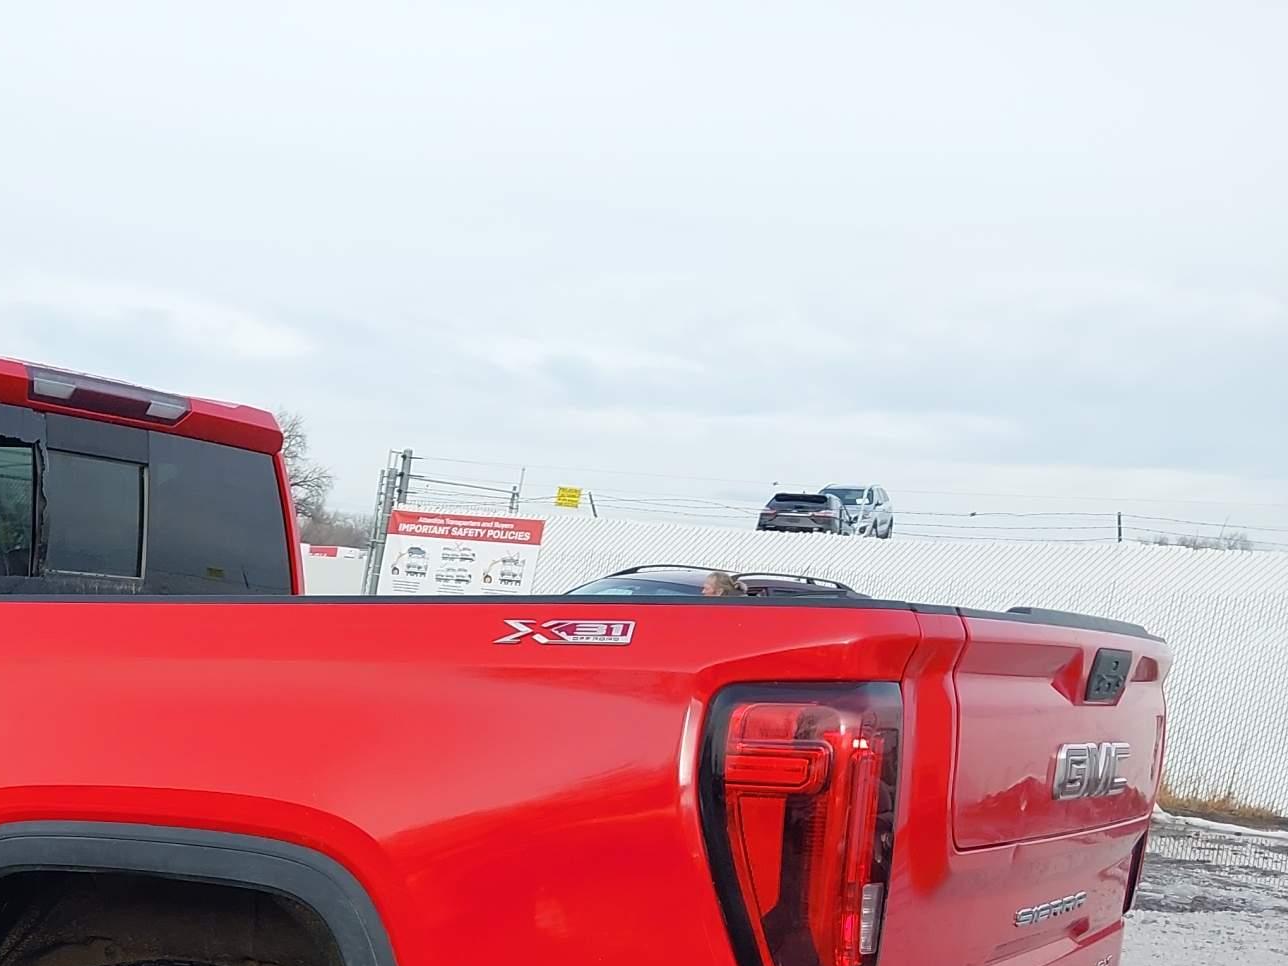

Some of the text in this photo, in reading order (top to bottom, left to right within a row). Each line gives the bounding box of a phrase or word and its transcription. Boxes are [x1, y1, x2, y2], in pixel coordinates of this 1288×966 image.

[398, 522, 531, 541] IMPORTANT SAFETY POLICIES
[481, 520, 493, 528] and
[1052, 742, 1132, 801] GMC
[1015, 890, 1087, 928] SIERRA
